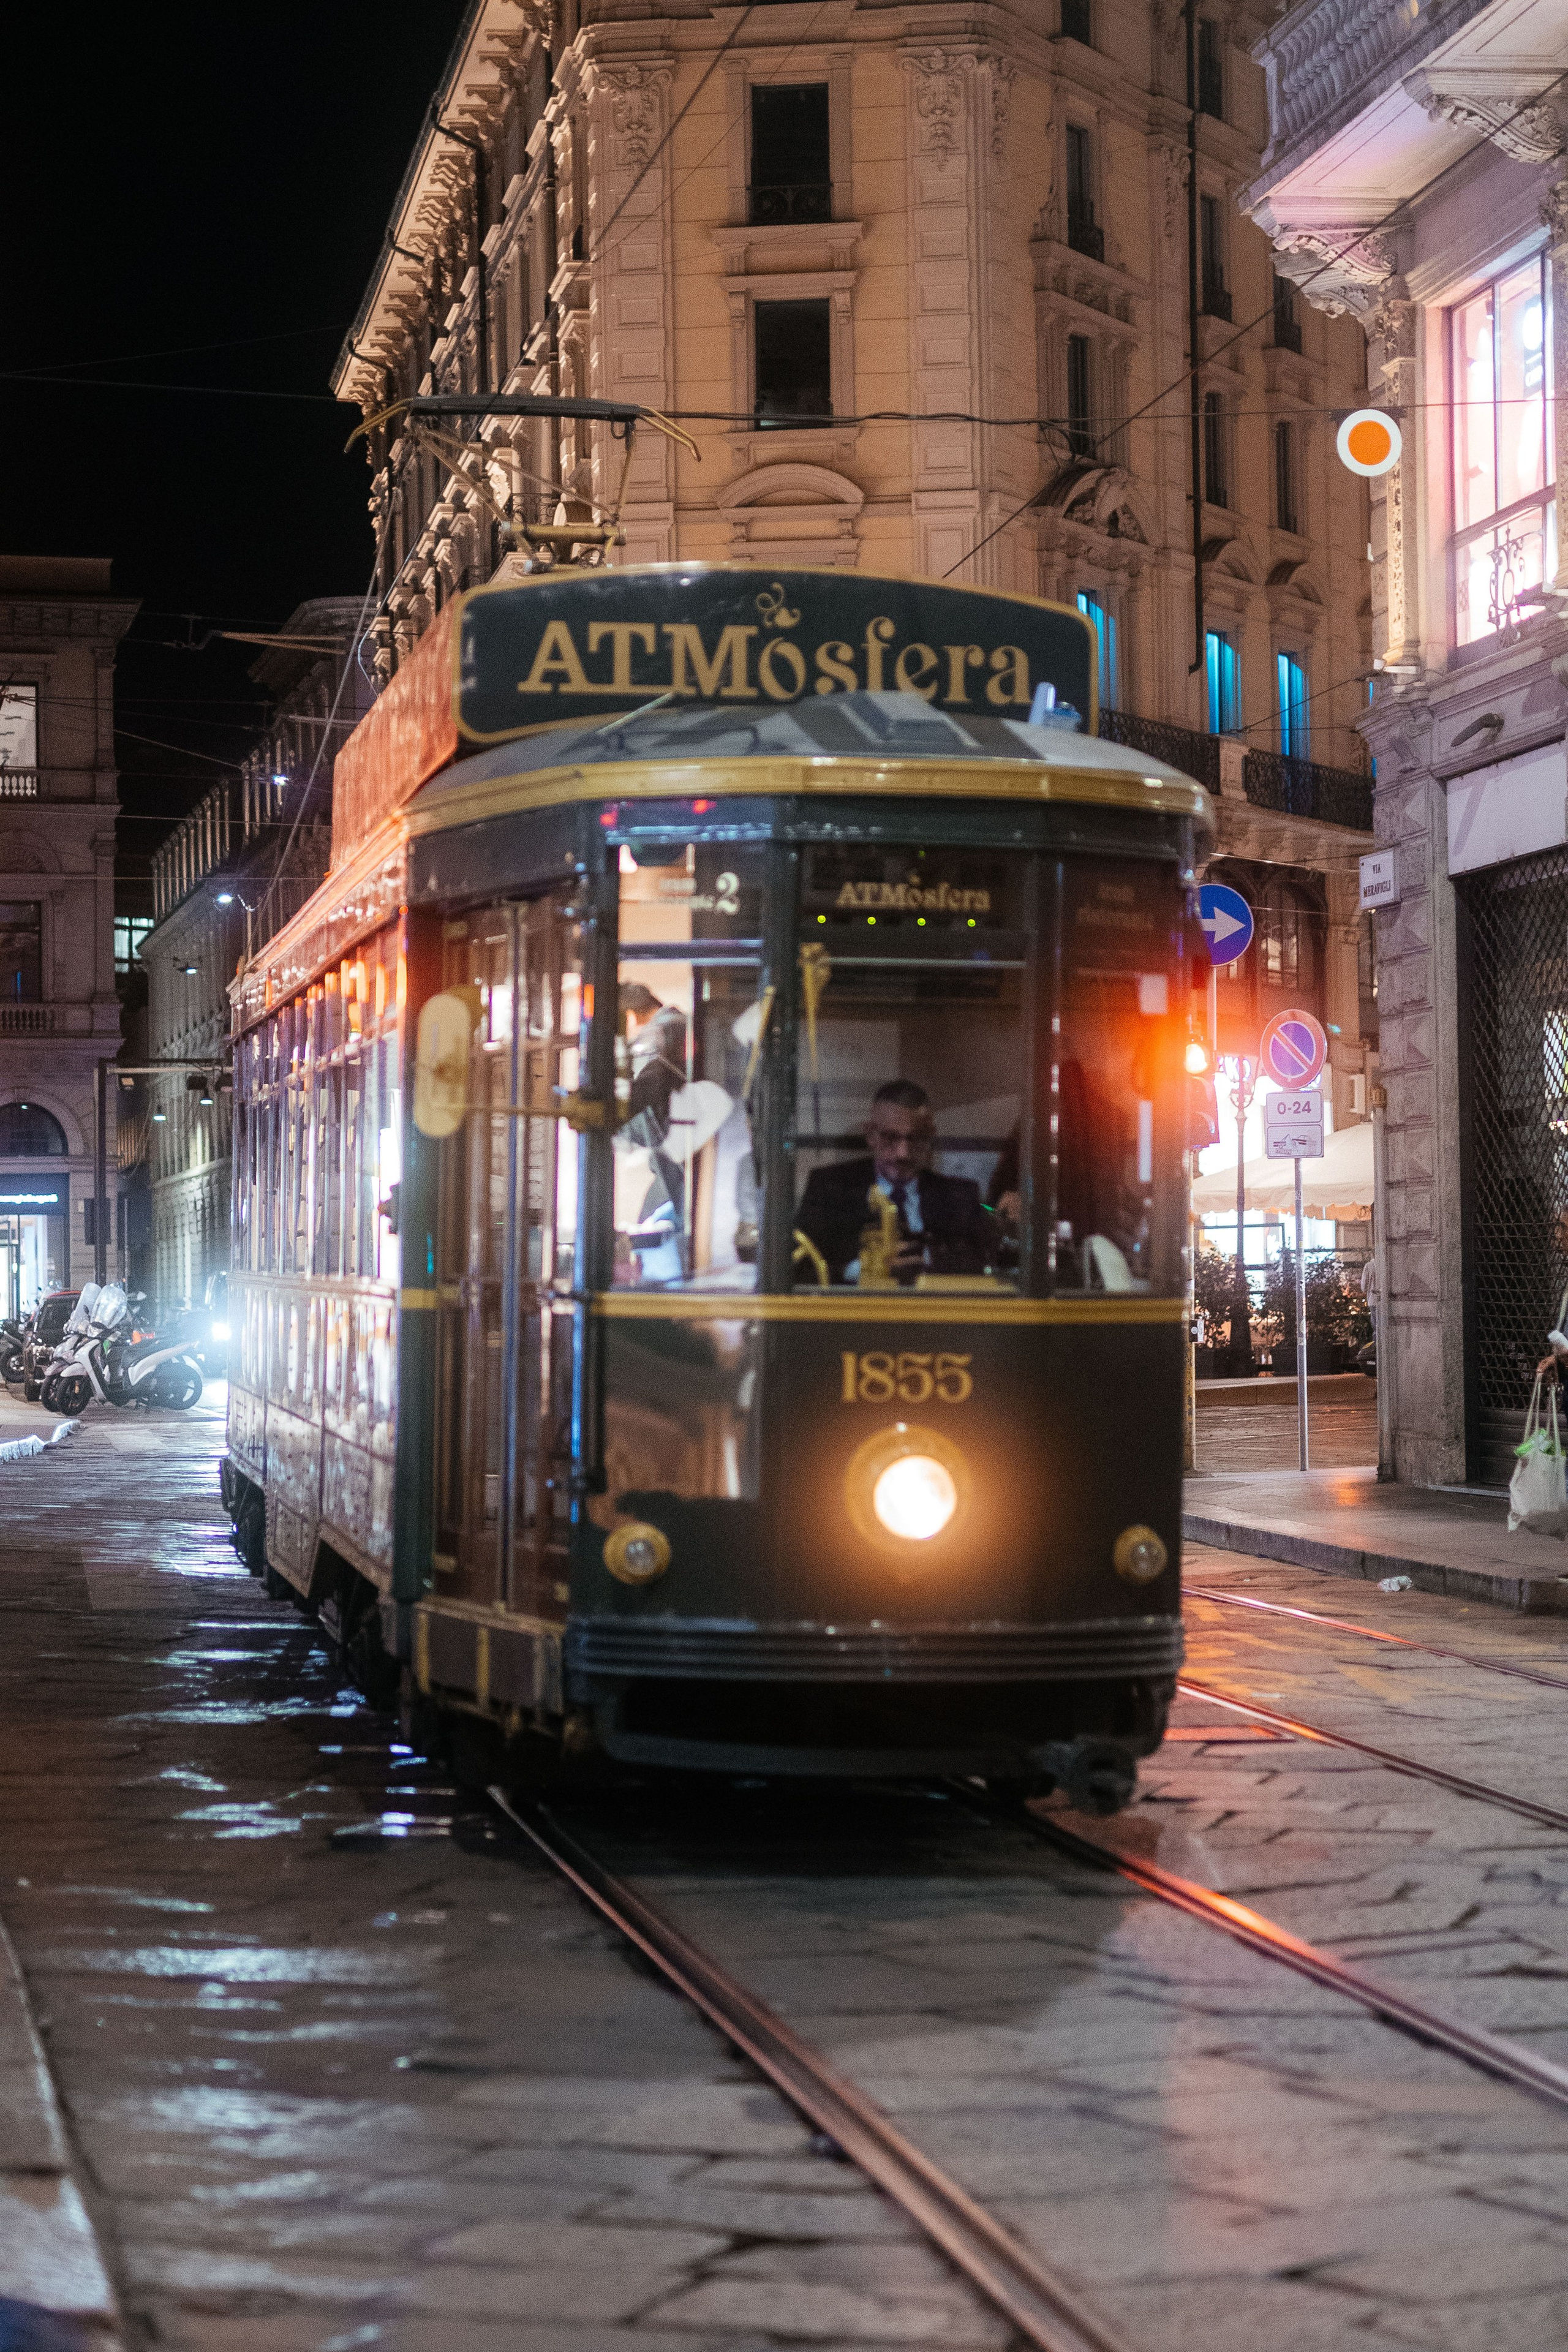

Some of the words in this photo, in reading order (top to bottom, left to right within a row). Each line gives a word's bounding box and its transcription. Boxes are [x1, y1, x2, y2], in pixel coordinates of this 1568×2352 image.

[1373, 864, 1381, 874] VIA
[715, 872, 739, 914] 2
[1363, 880, 1392, 899] MERAVIGLI
[1276, 1101, 1312, 1115] 0-24
[842, 1351, 973, 1403] 1855
